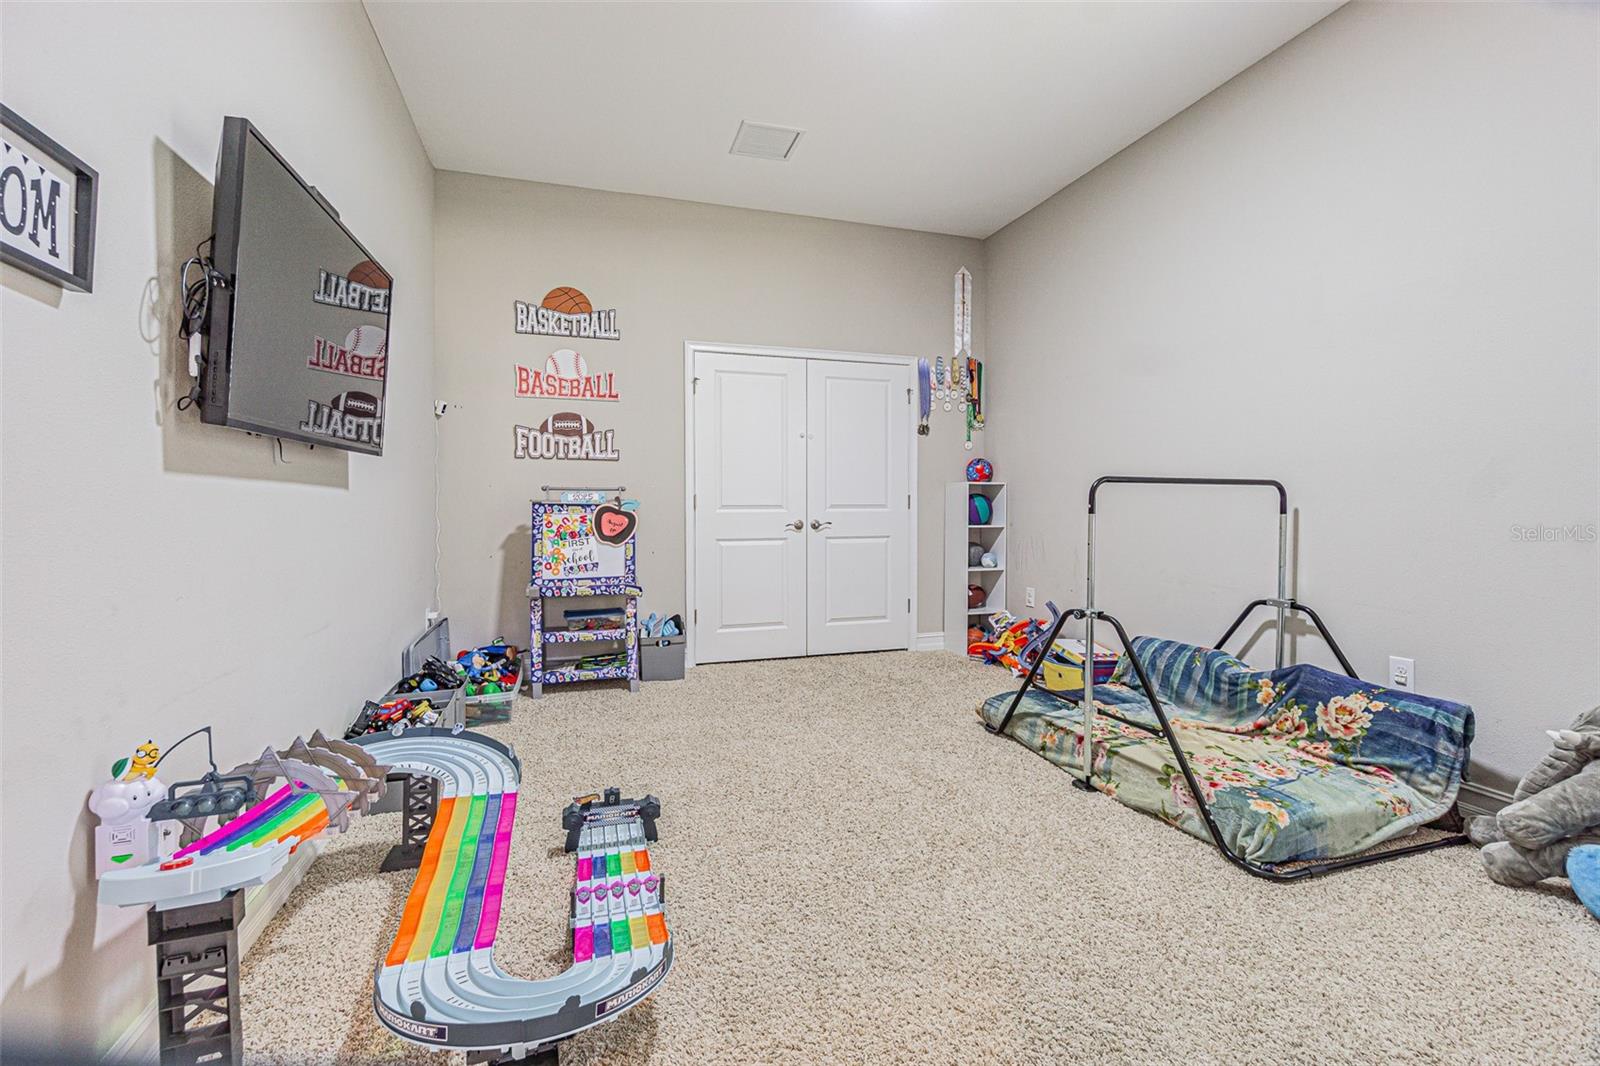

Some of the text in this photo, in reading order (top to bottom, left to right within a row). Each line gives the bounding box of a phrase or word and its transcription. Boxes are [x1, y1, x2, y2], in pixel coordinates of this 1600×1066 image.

[515, 301, 620, 339] BASKETBALL
[517, 366, 619, 398] BASEBALL
[515, 425, 619, 460] FOOTBALL
